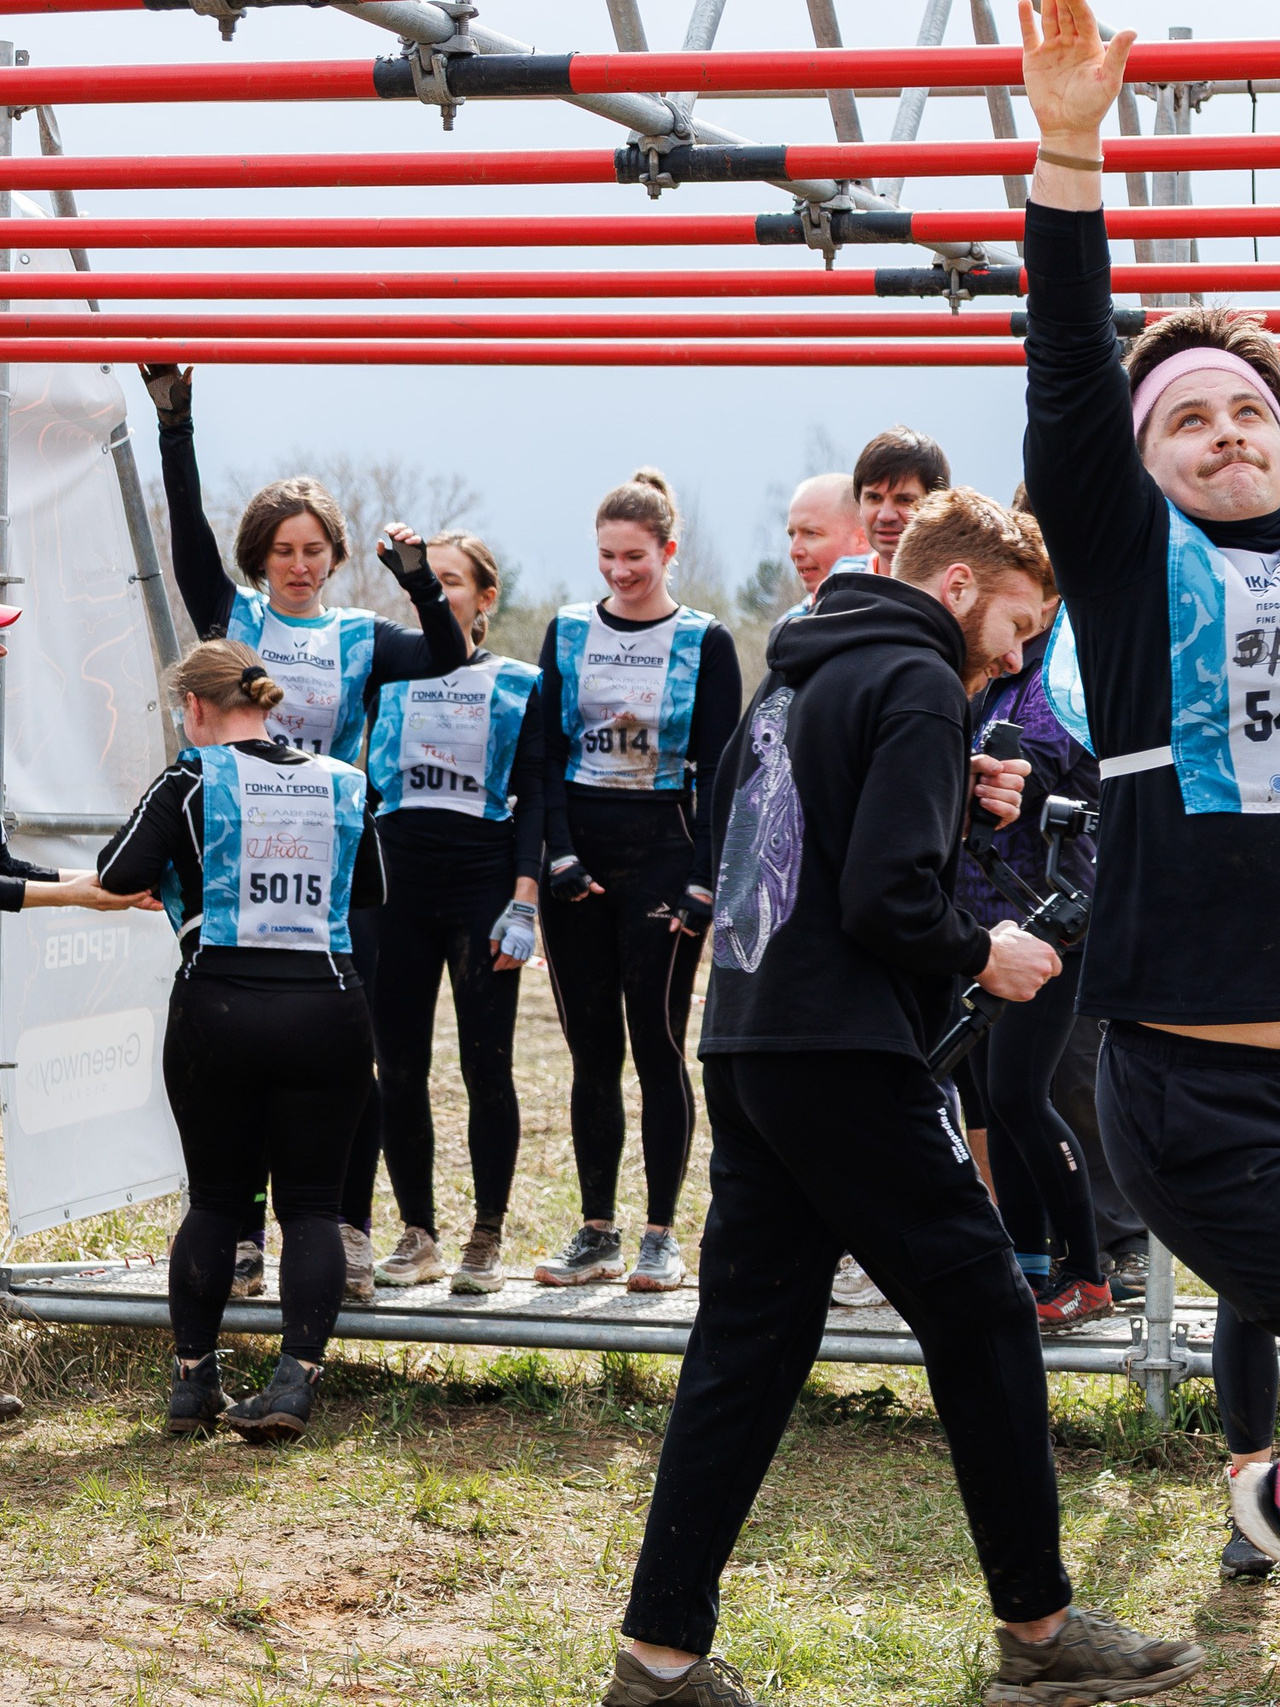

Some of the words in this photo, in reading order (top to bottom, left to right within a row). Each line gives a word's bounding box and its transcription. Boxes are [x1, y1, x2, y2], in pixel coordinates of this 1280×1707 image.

[1256, 615, 1276, 624] FINE
[262, 649, 295, 662] ГОНКА
[297, 651, 335, 667] ГЕРОЕВ
[588, 653, 621, 663] ГОНКА
[624, 655, 664, 666] ГЕРОЕВ
[411, 690, 444, 700] ГОНКА
[447, 691, 487, 701] ГЕРОЕВ
[271, 733, 322, 756] 011
[410, 764, 479, 793] 5012
[245, 783, 283, 793] ГОНКА
[286, 784, 329, 795] ГЕРОЕВ
[250, 872, 323, 907] 5015
[270, 925, 315, 934] ГАЗПРОМБАНК
